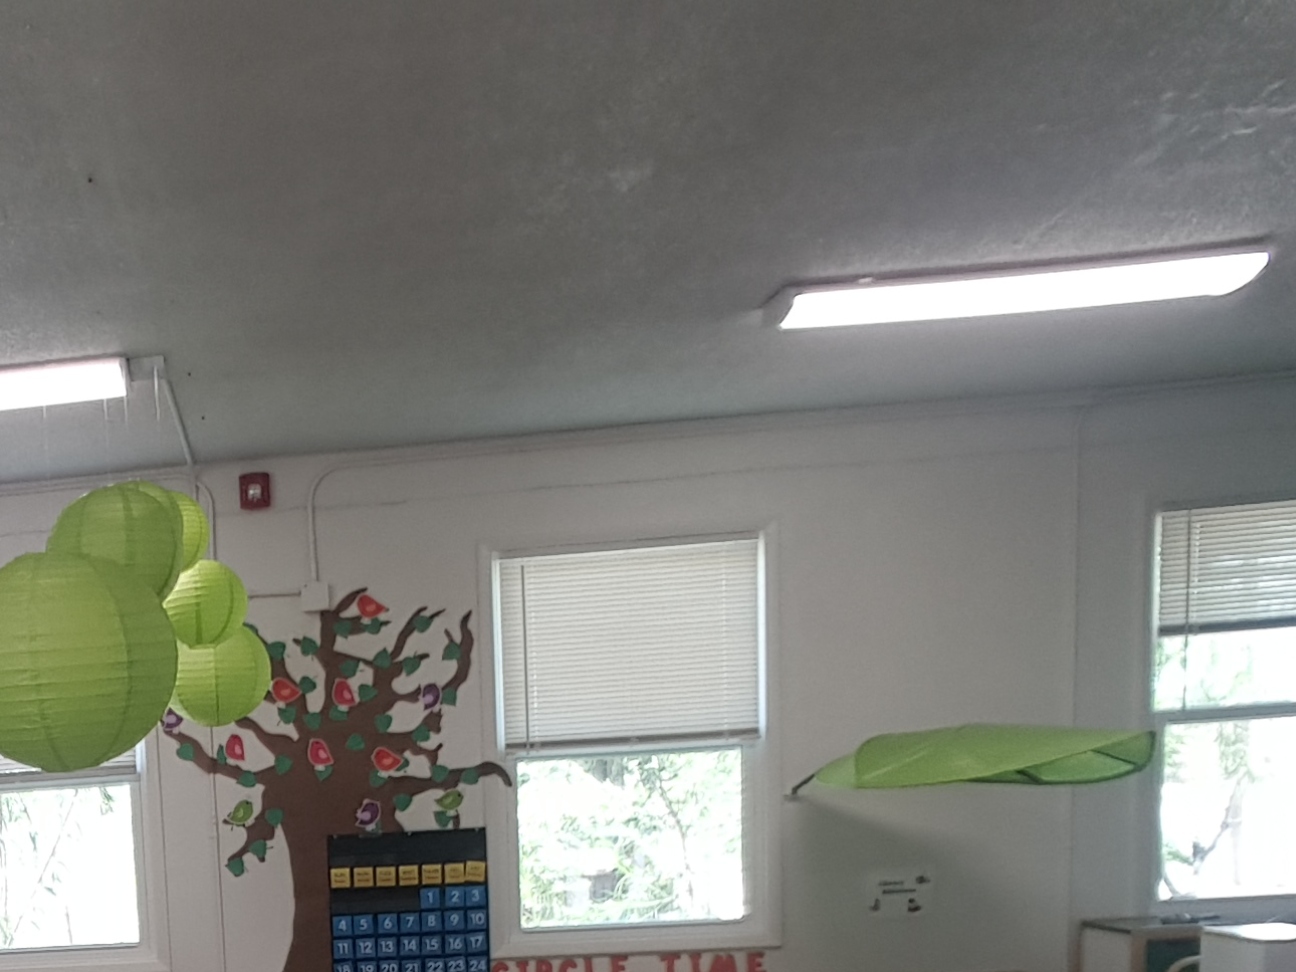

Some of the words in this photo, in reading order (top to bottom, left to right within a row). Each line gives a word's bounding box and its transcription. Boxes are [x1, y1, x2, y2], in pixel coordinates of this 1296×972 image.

[428, 893, 433, 904] 1
[451, 890, 459, 902] 2
[472, 890, 480, 901] 3
[338, 920, 346, 932] 4
[360, 919, 368, 930] 5
[384, 918, 392, 929] 6
[406, 916, 414, 927] 7
[428, 915, 436, 926] 8
[450, 914, 458, 926] 9
[471, 913, 484, 925] 10
[338, 942, 348, 954] 11
[359, 942, 372, 953] 12
[380, 940, 394, 952] 13
[404, 940, 417, 950] 14
[426, 938, 438, 950] 15
[449, 938, 462, 950] 16
[470, 936, 483, 948] 17
[427, 962, 443, 972] 22
[448, 960, 464, 972] 23
[469, 960, 486, 972] 24
